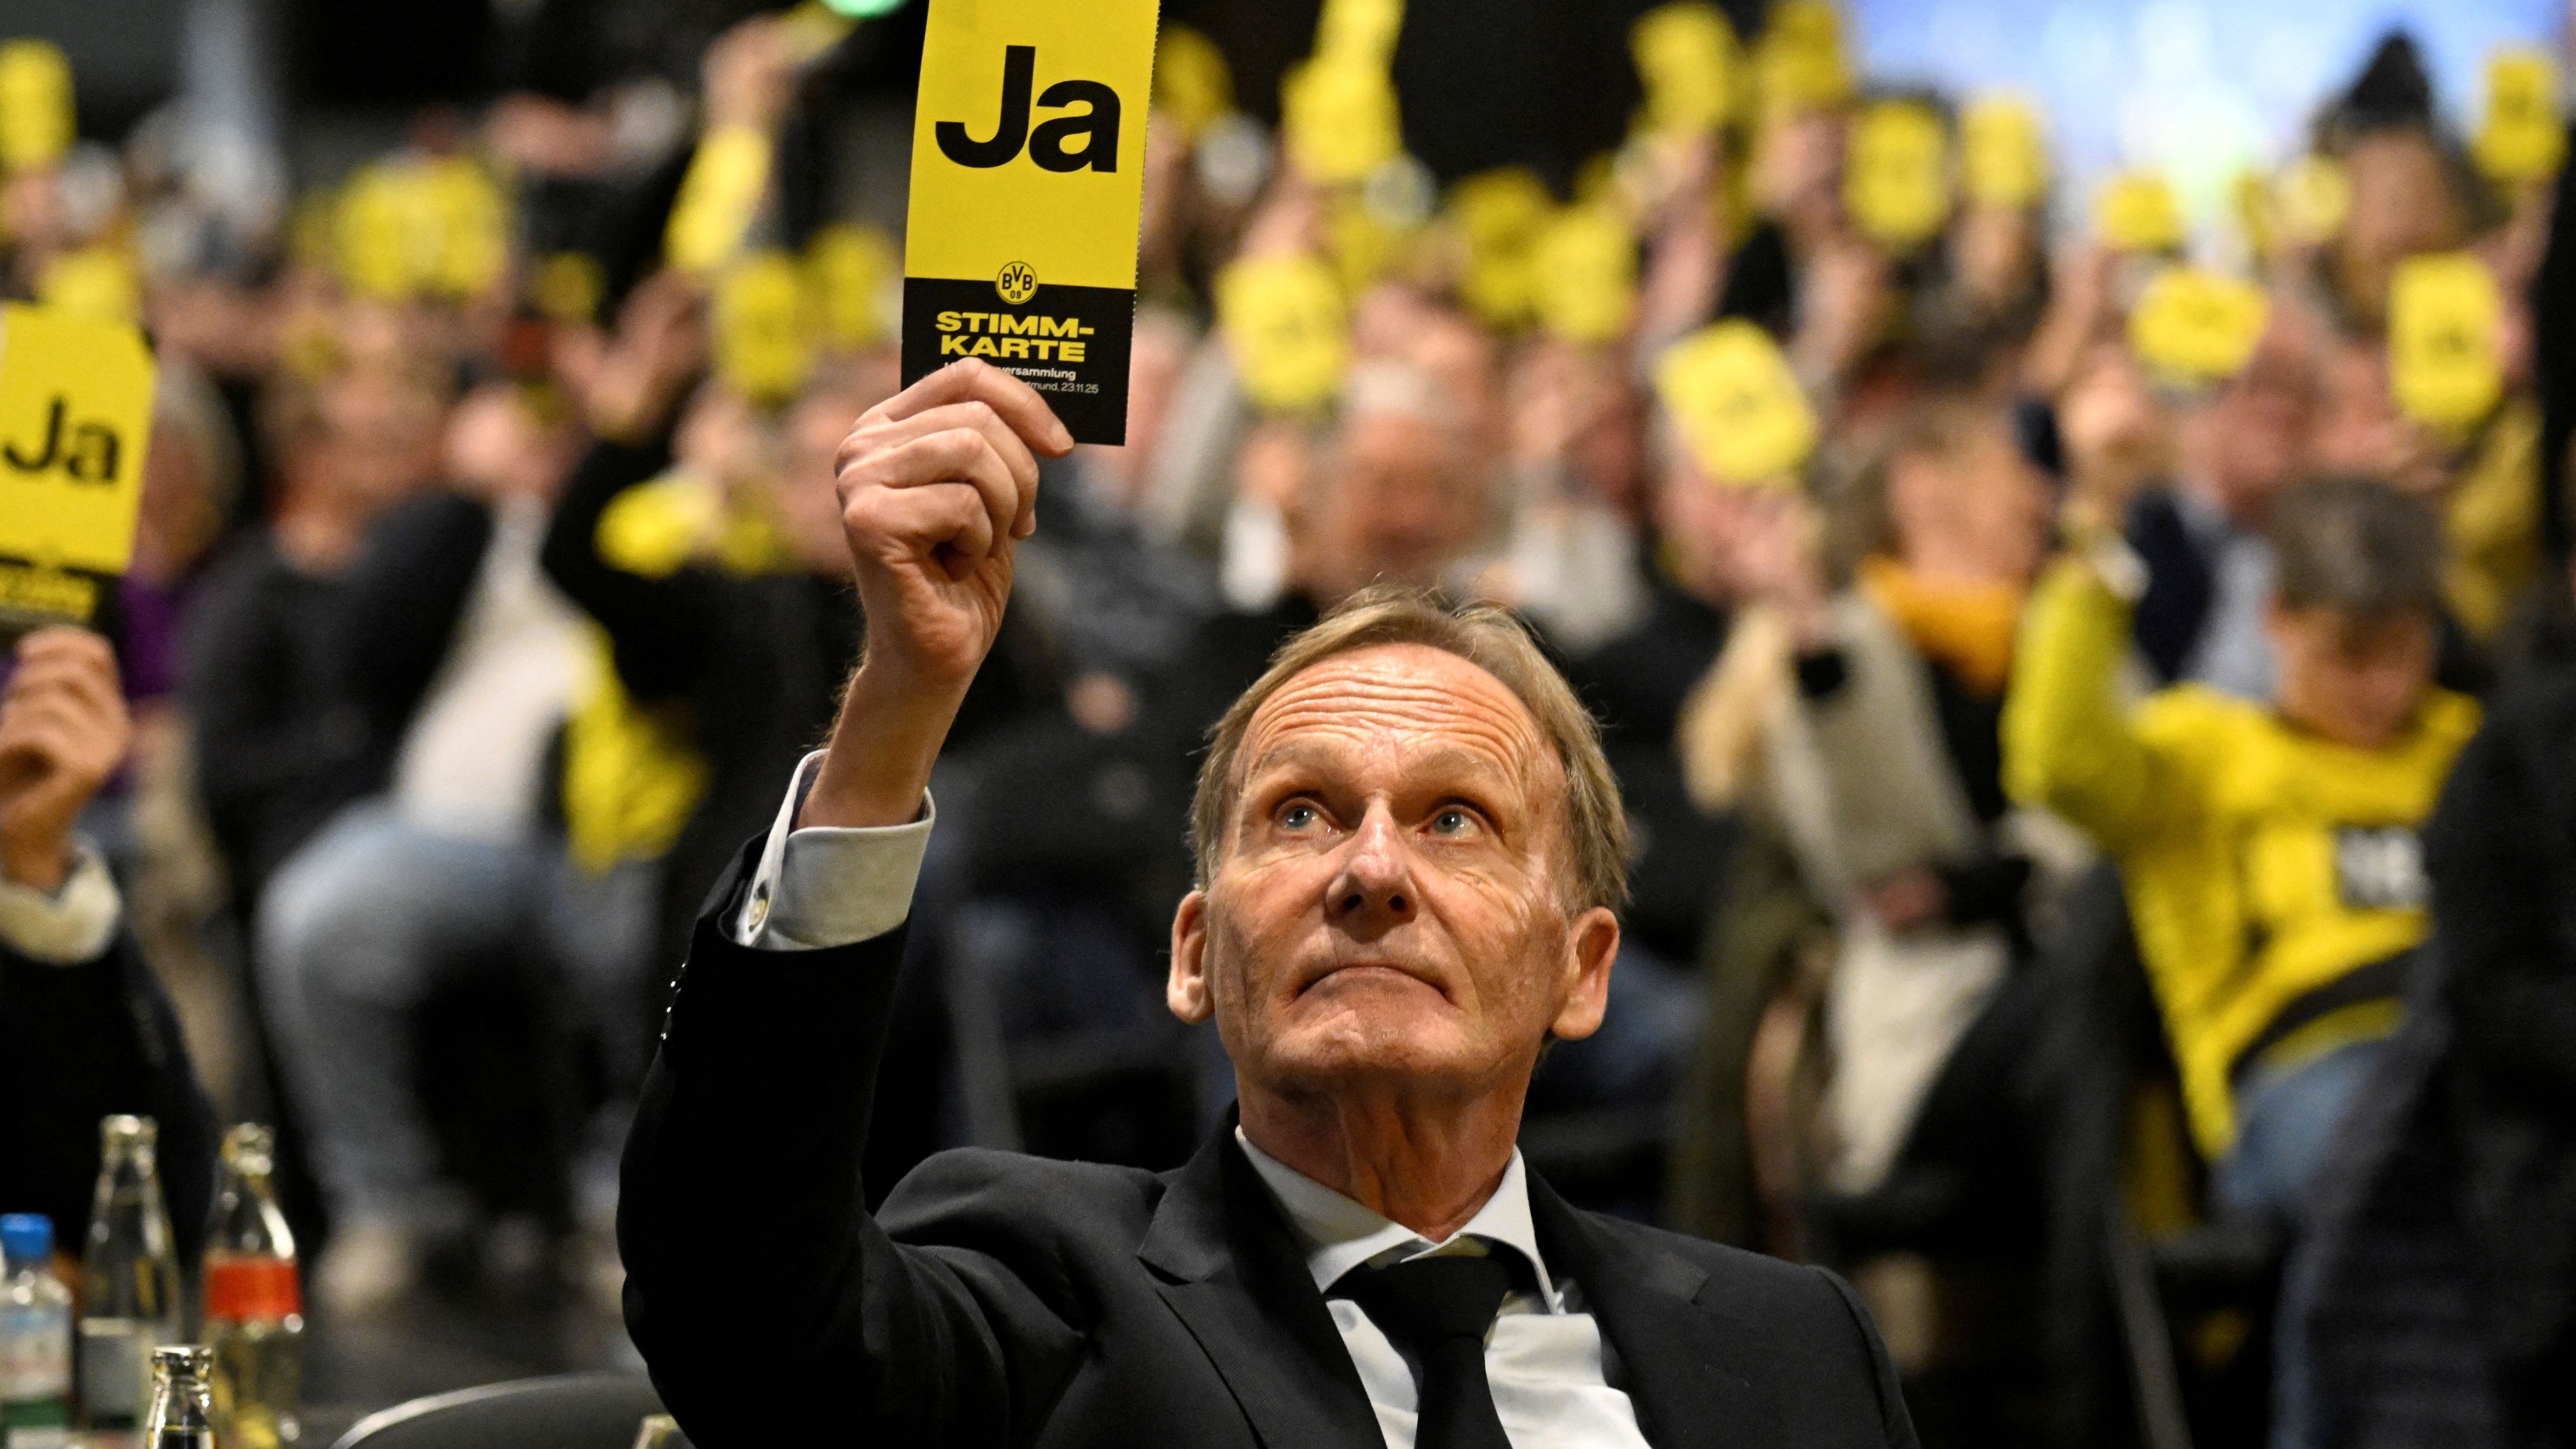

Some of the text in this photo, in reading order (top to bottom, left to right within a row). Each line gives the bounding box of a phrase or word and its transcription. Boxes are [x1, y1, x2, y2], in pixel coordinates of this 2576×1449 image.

[935, 45, 1121, 173] Ja
[1002, 265, 1033, 291] BVB
[935, 311, 1094, 338] STIMM-
[941, 335, 1086, 362] KARTE
[2, 394, 119, 484] Ja
